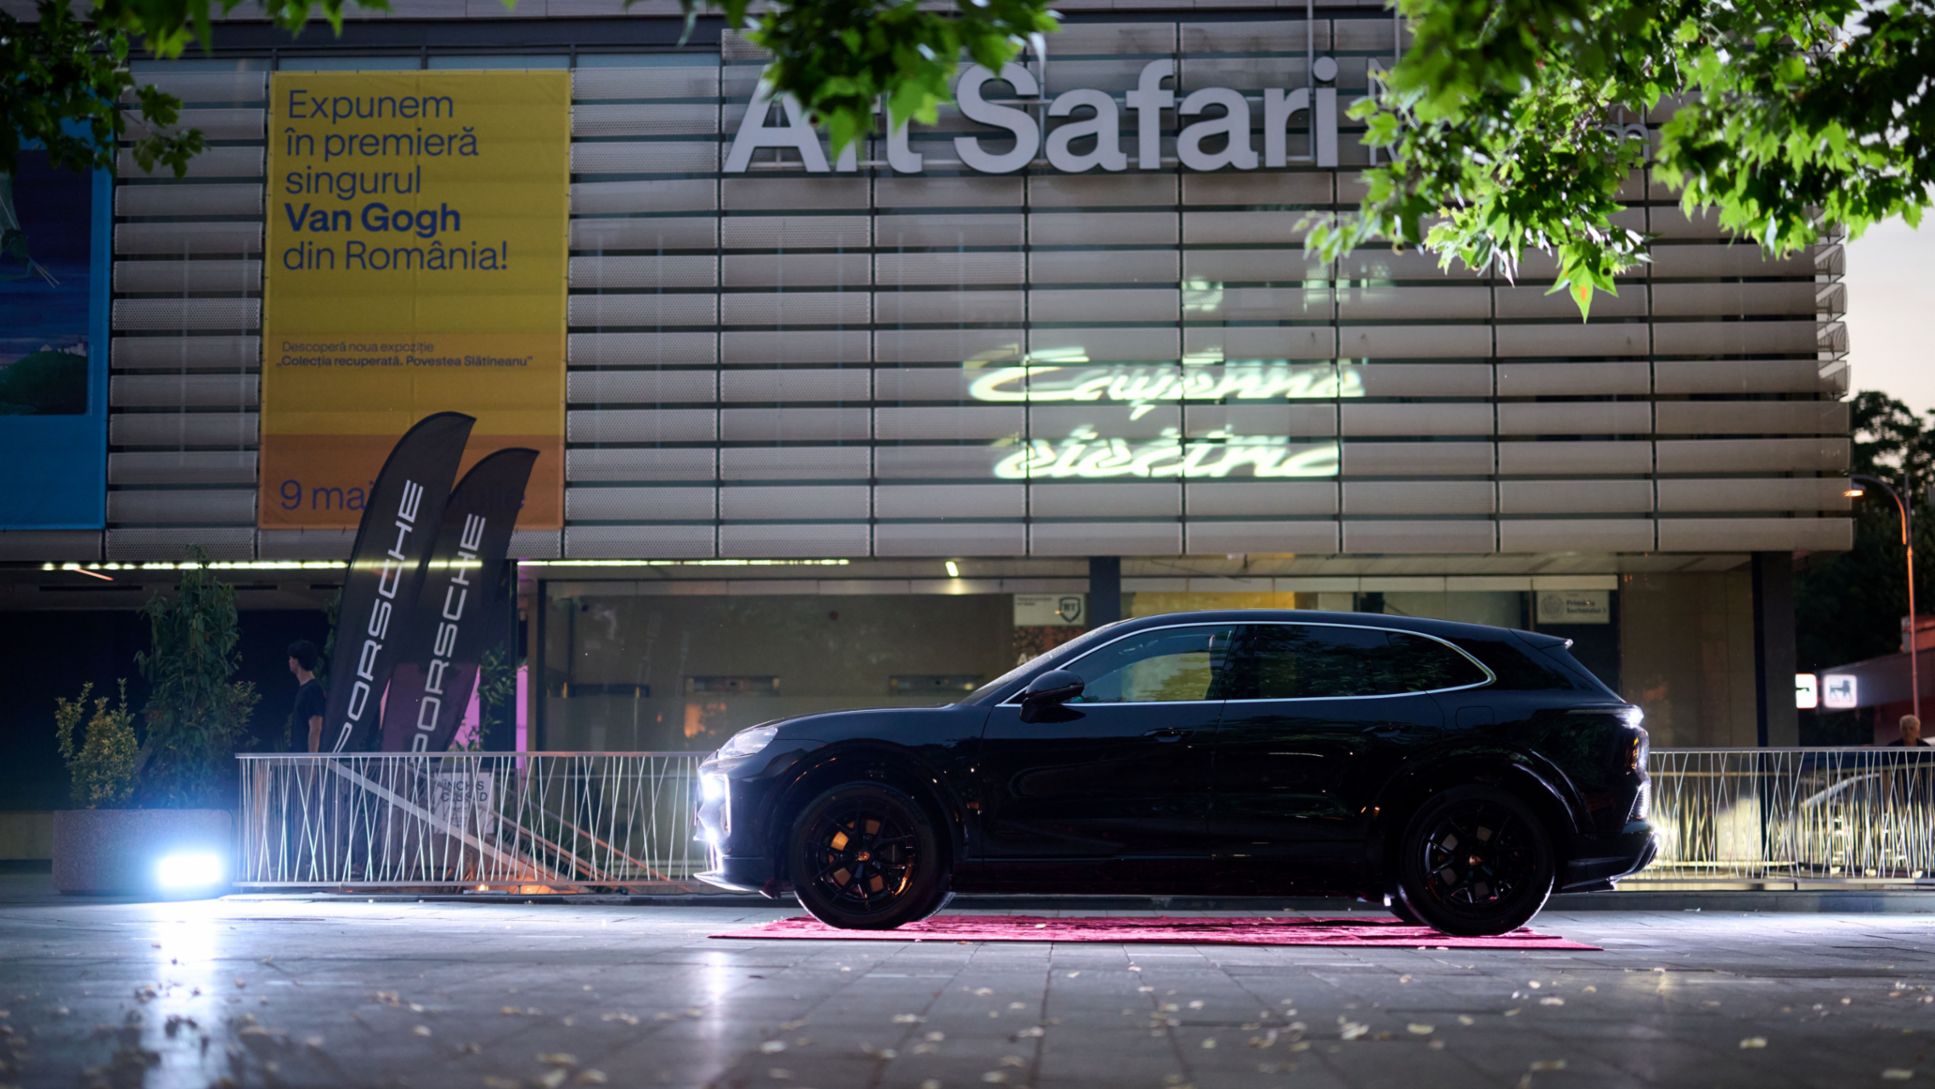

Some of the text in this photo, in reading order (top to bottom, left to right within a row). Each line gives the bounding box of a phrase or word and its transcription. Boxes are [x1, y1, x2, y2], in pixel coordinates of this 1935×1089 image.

[288, 90, 453, 124] Expunem
[954, 56, 1338, 174] Safari
[285, 126, 479, 162] în premieră
[285, 165, 421, 200] singurul
[284, 202, 461, 238] Van Gogh
[283, 240, 507, 270] din România!
[282, 341, 347, 354] Descoperă
[349, 343, 378, 352] noua
[406, 355, 462, 367] Povestea
[279, 479, 301, 511] 9
[332, 480, 424, 753] PORSCHE
[411, 513, 486, 754] PORSCHE
